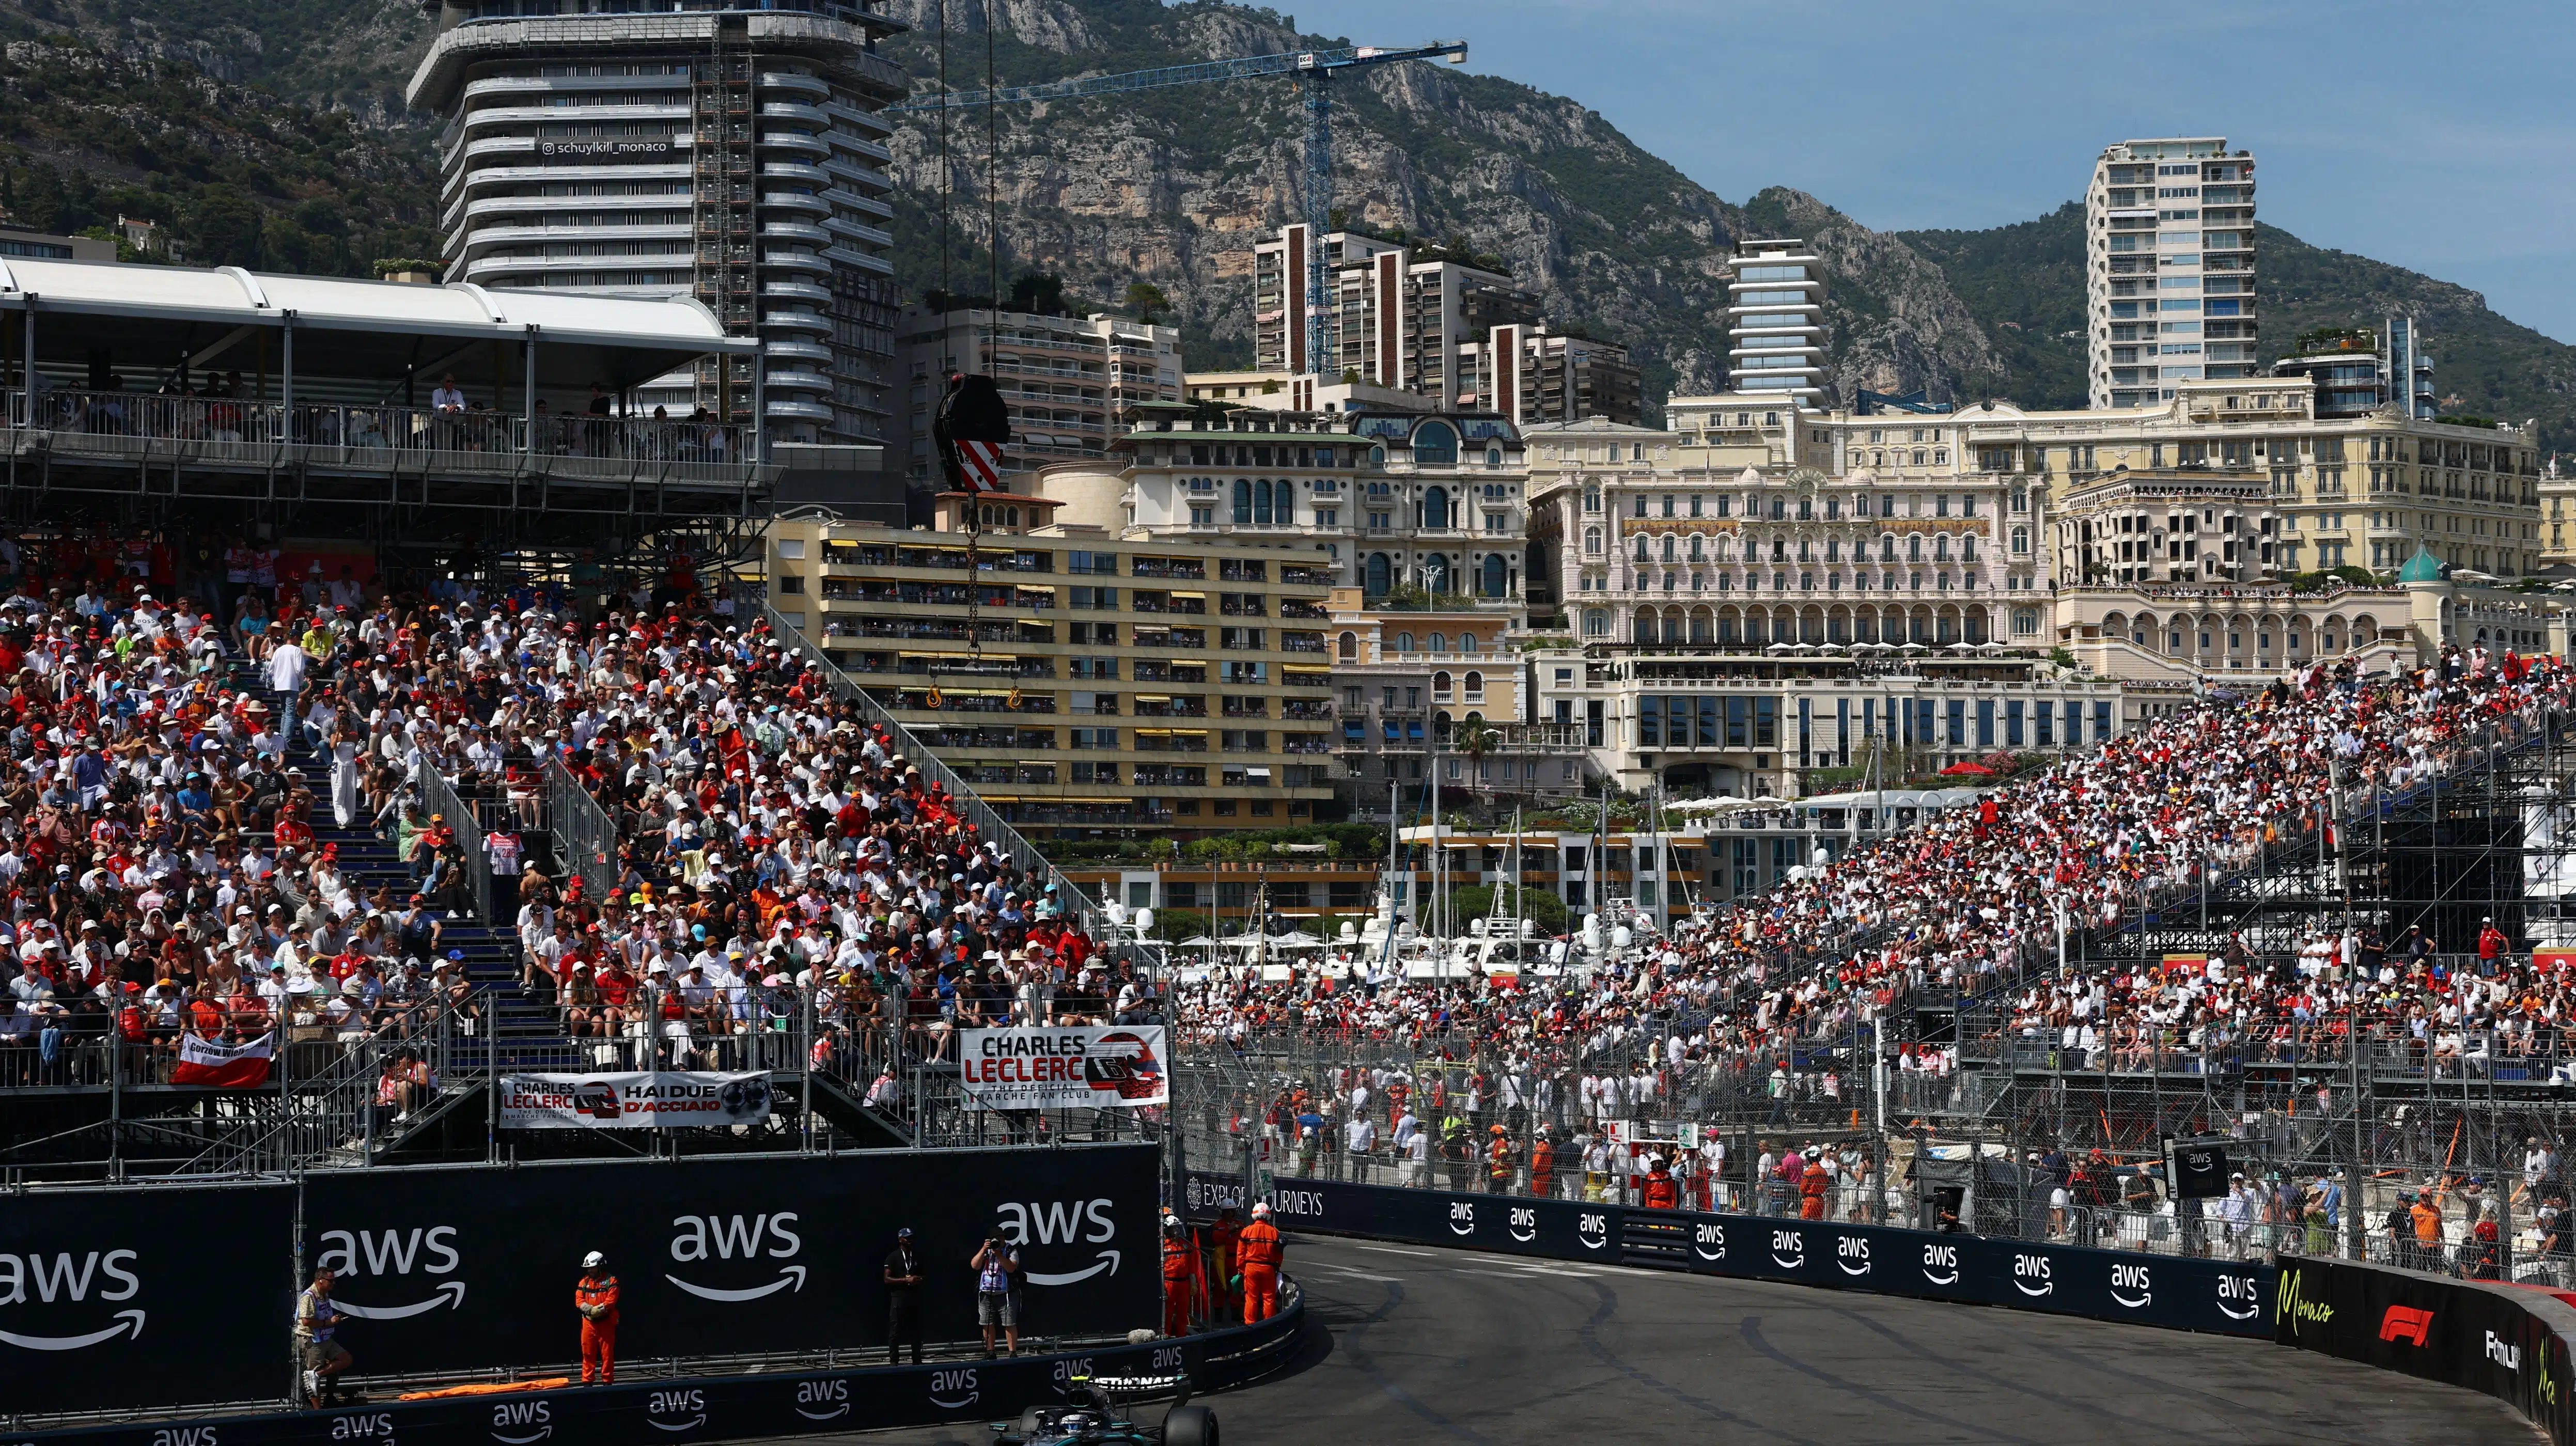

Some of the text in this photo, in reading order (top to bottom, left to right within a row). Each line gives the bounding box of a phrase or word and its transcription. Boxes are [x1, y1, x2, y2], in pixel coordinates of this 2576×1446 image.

[558, 142, 666, 155] schuylkill_monaco
[190, 1042, 221, 1057] Gorzów
[981, 1035, 1086, 1057] CHARLES
[965, 1057, 1083, 1083] LECLERC
[513, 1082, 575, 1094] CHARLES
[625, 1086, 716, 1098] HAI DUE
[976, 1093, 1026, 1101] MARCHE
[504, 1094, 573, 1109] LECLERC
[624, 1101, 721, 1113] D'ACCIAIO
[2189, 1152, 2211, 1164] aws
[1204, 1183, 1322, 1216] EXPLO URNEYS
[997, 1198, 1115, 1246] aws
[1450, 1202, 1473, 1221] aws
[1510, 1207, 1535, 1227] aws
[1580, 1213, 1605, 1234] aws
[1696, 1223, 1724, 1245] aws
[671, 1212, 800, 1262] aws
[1773, 1230, 1802, 1252] aws
[1838, 1236, 1869, 1259] aws
[318, 1225, 459, 1277] aws
[1924, 1244, 1957, 1268] aws
[2015, 1254, 2050, 1279] aws
[2112, 1264, 2149, 1289] aws
[2218, 1275, 2257, 1301] aws
[2276, 1268, 2334, 1337] Monaco
[1054, 1358, 1092, 1380] aws
[1153, 1346, 1182, 1369] aws
[798, 1379, 848, 1403] aws
[931, 1369, 977, 1392] aws
[649, 1389, 704, 1413] aws
[494, 1401, 550, 1426] aws
[153, 1426, 217, 1446] aws
[332, 1413, 393, 1439] aws
